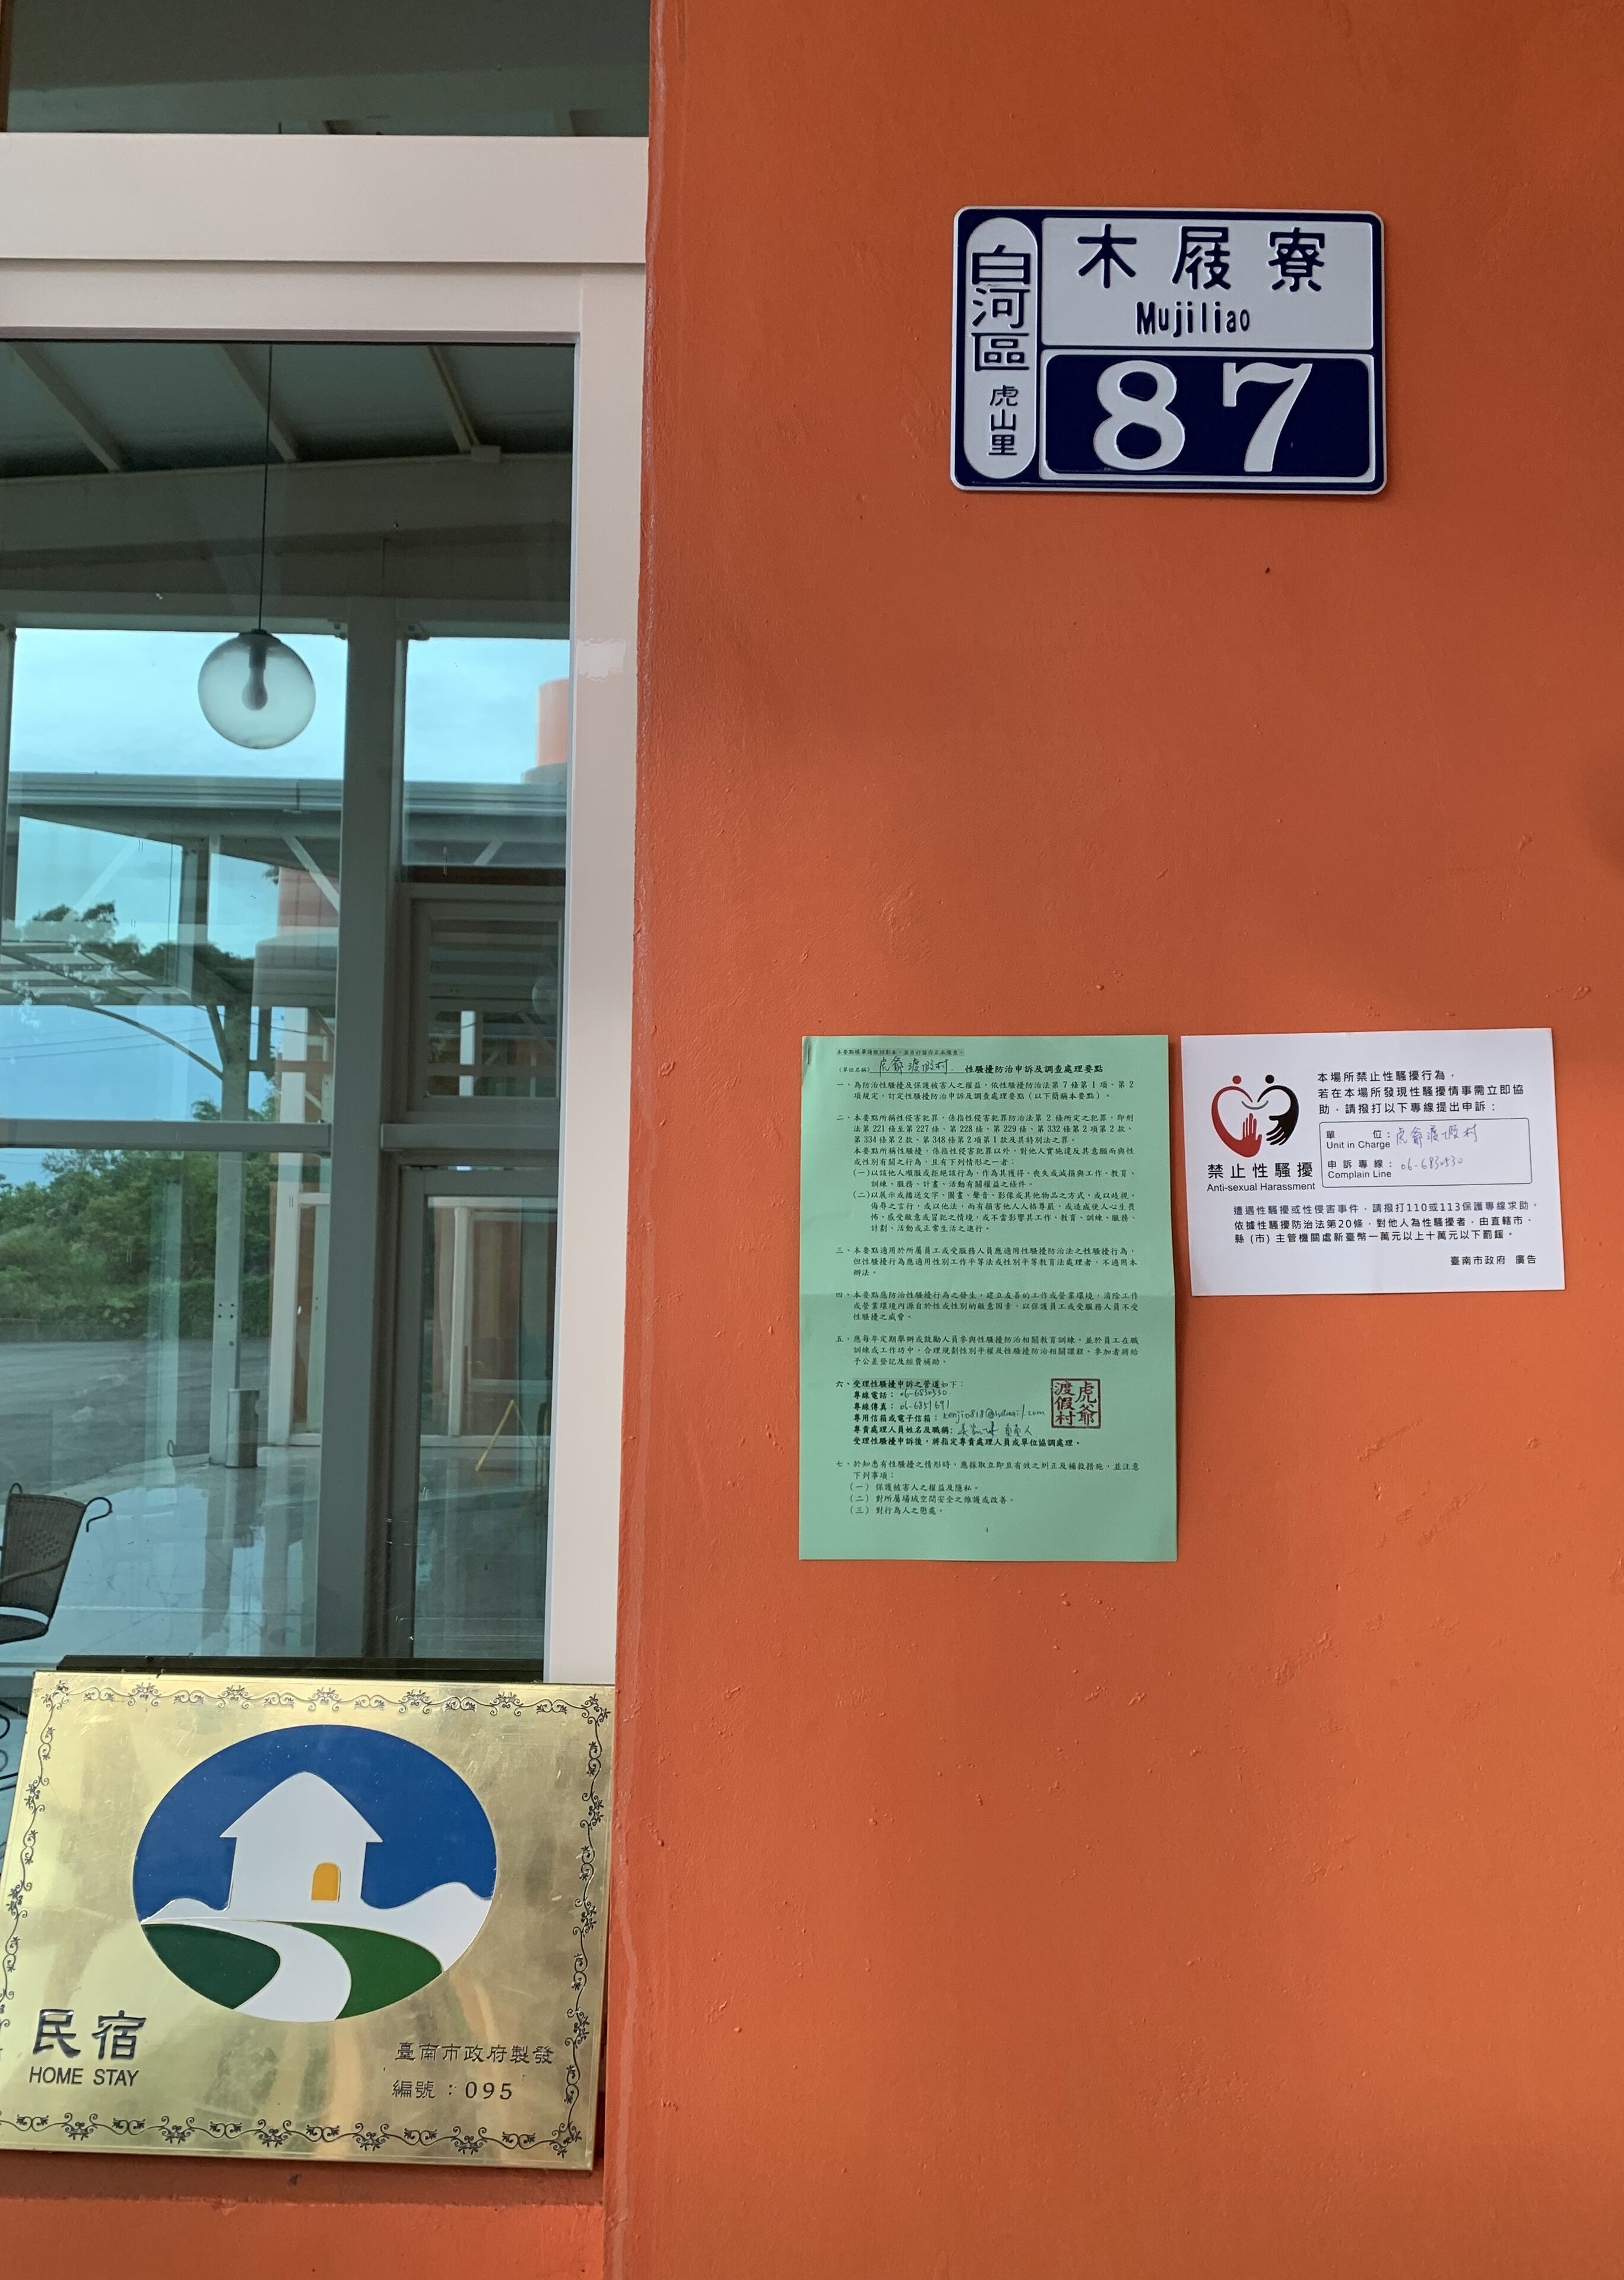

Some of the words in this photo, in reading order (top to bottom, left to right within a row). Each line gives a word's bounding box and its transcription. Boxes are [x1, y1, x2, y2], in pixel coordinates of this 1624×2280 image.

[1077, 224, 1325, 292] 木屐寮
[970, 245, 1031, 372] 白河區
[1136, 301, 1251, 338] Mujiliao
[988, 385, 1019, 456] 虎山里
[1092, 359, 1313, 473] 87
[965, 1064, 1103, 1074] 性騷擾防治申訴及調查處理要點
[1318, 1084, 1524, 1098] 若在本場所發現性騷擾情事需立即協
[1358, 1141, 1391, 1150] Charge
[1207, 1162, 1313, 1179] 禁止性騷擾
[1328, 1170, 1370, 1180] Complain
[1373, 1170, 1392, 1179] Line
[1207, 1183, 1257, 1192] Anti-sexual
[1261, 1182, 1315, 1191] Harassment
[1450, 1255, 1506, 1266] 臺南市政府
[1515, 1254, 1537, 1265] 廣告
[1054, 1380, 1076, 1426] 渡假村
[1075, 1381, 1098, 1426] 虎爺
[33, 2008, 147, 2061] 民宿
[395, 2041, 555, 2064] 臺南市政府製發
[28, 2066, 83, 2086] HOME
[93, 2067, 139, 2087] STAY
